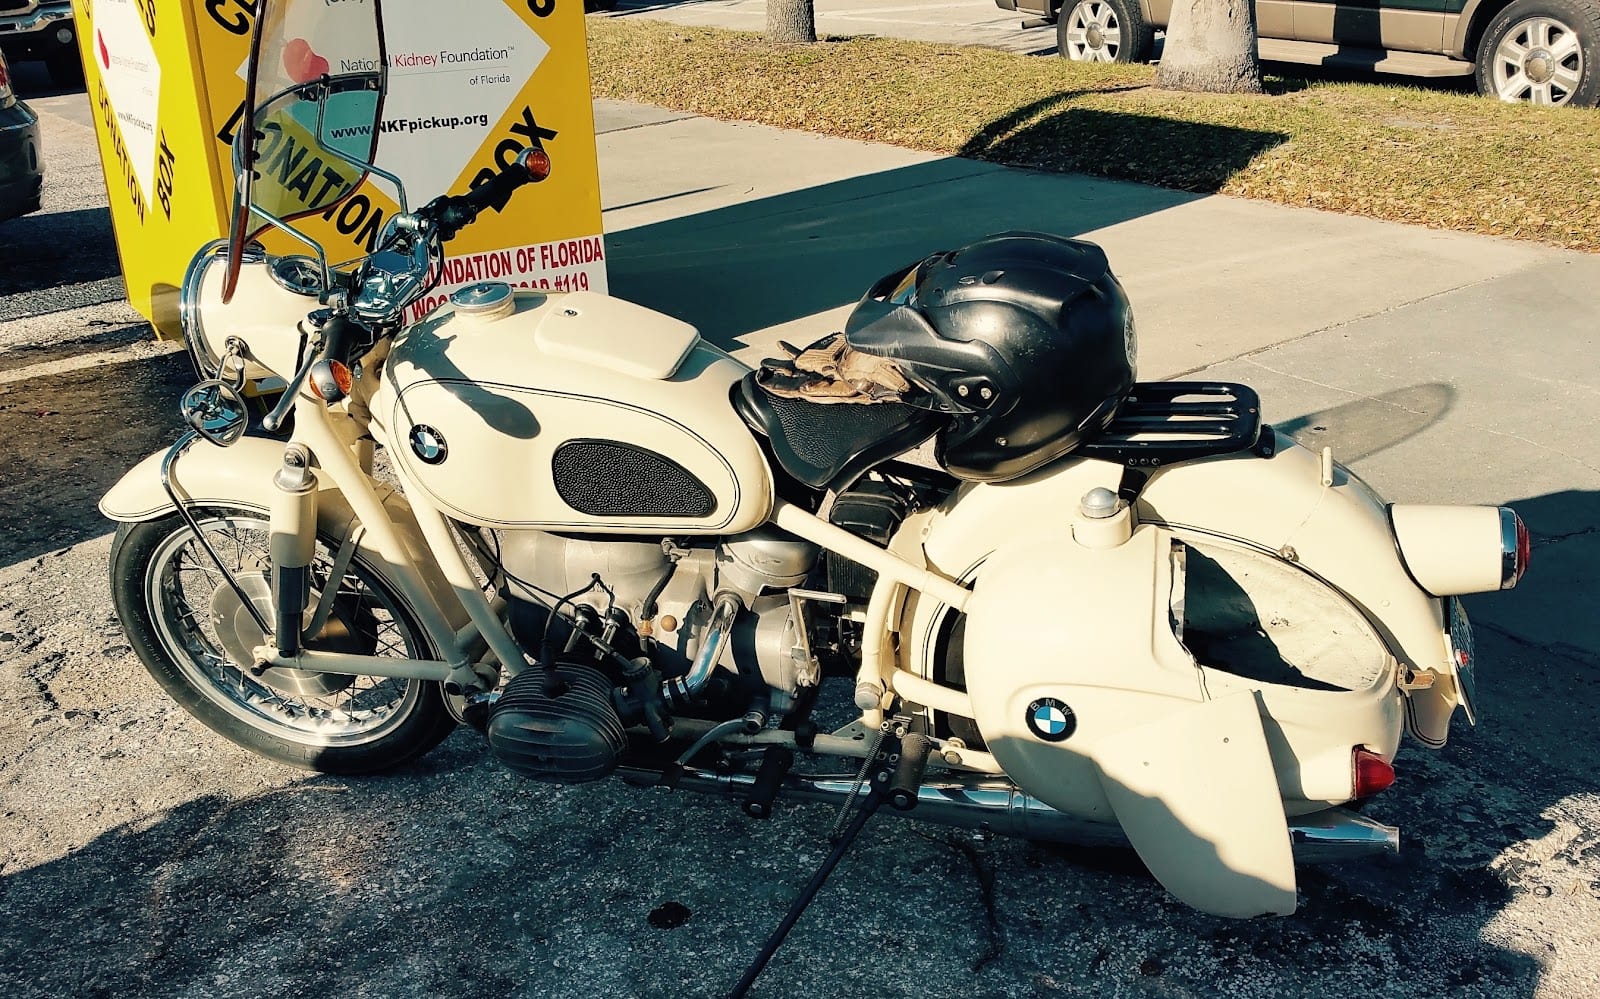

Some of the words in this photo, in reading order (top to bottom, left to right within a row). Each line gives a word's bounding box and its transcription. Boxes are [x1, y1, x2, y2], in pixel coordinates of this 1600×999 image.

[340, 54, 392, 72] Nationl
[395, 53, 438, 68] Kidney
[469, 76, 478, 86] of
[481, 74, 511, 85] Florida
[331, 114, 488, 138] www.NKFpickup.org
[98, 79, 145, 227] DONATION
[157, 127, 176, 223] BOX
[516, 247, 536, 274] OF
[541, 237, 604, 270] FLORIDA
[554, 271, 589, 293] #119
[1030, 698, 1073, 717] BMW
